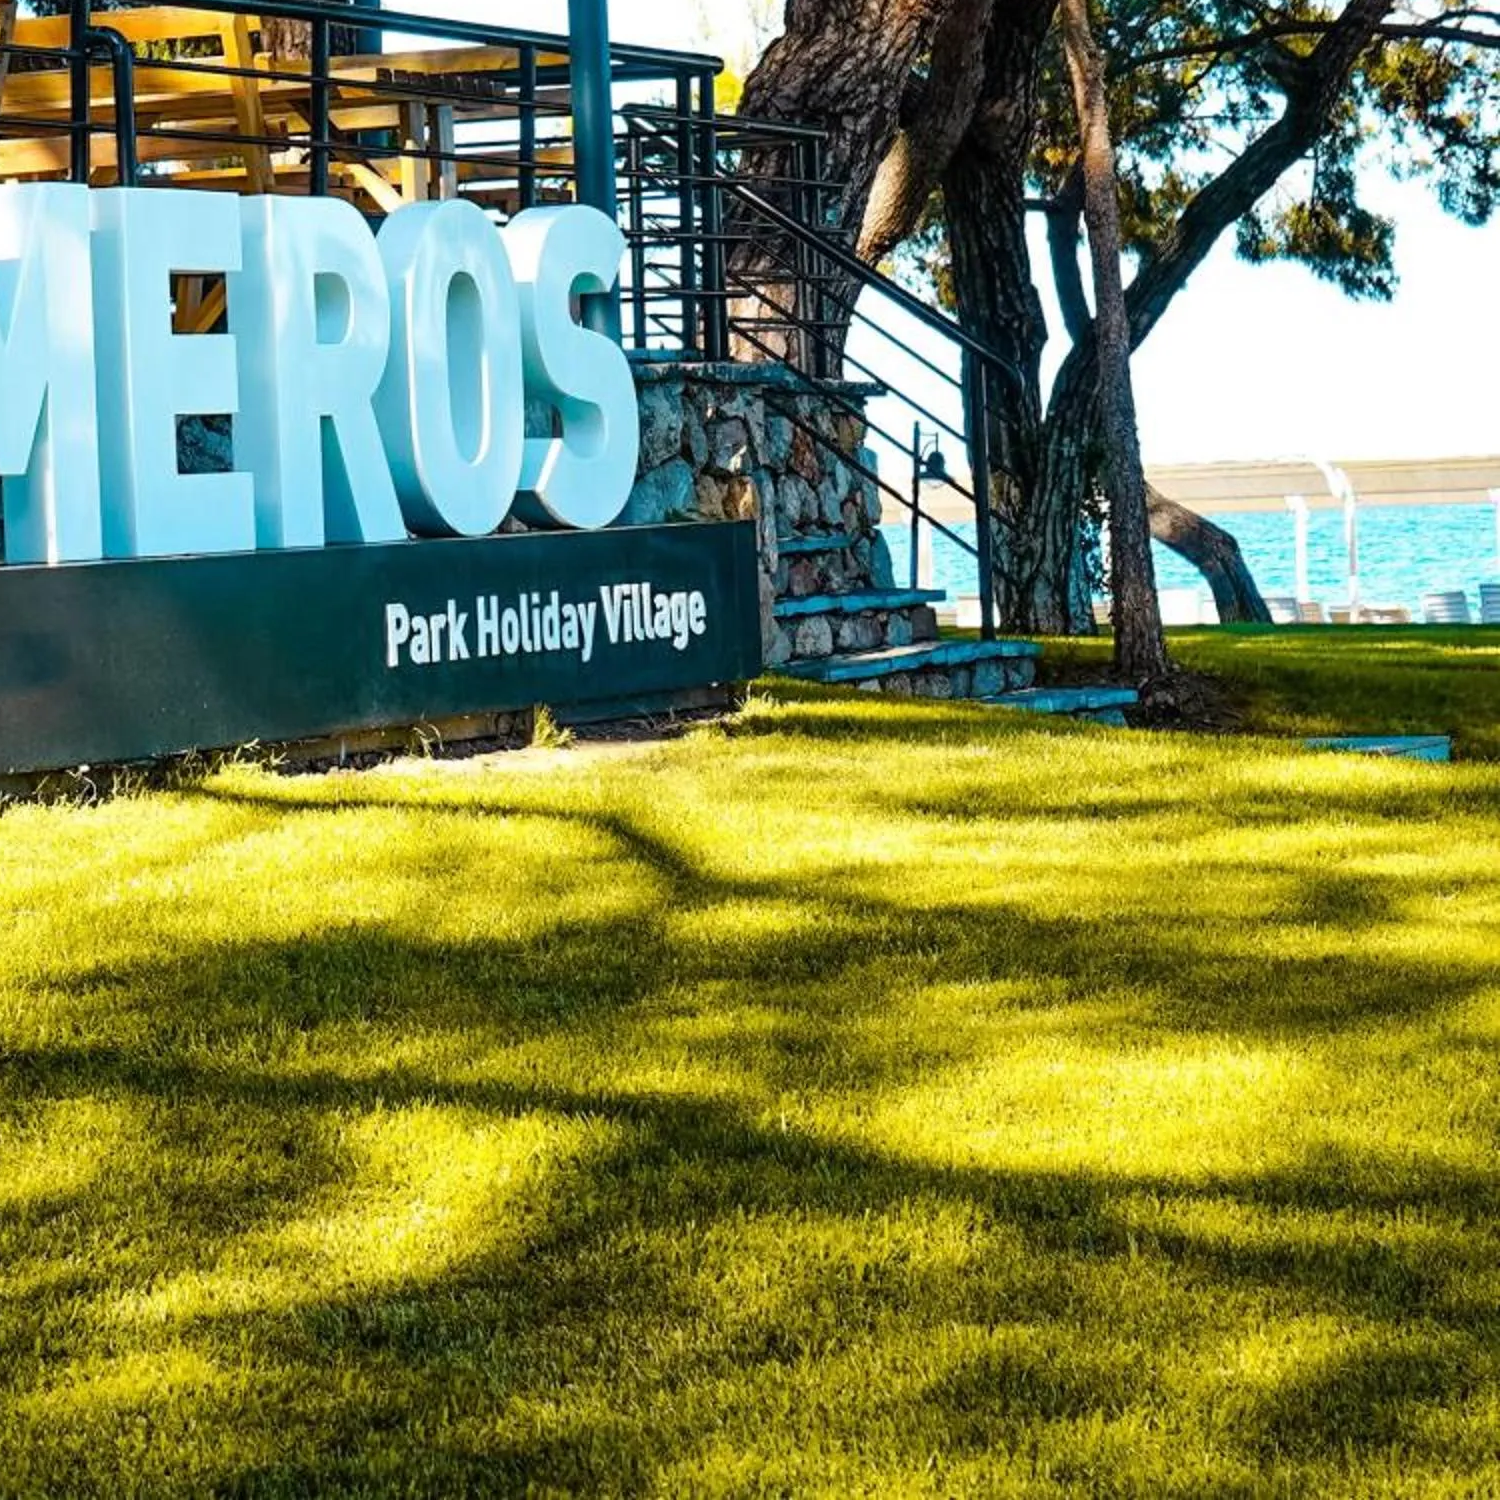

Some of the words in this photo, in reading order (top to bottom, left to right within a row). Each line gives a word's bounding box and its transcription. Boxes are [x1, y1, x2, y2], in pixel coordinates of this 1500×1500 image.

[385, 598, 471, 668] Park
[476, 590, 597, 663] Holiday
[600, 581, 707, 651] Village
